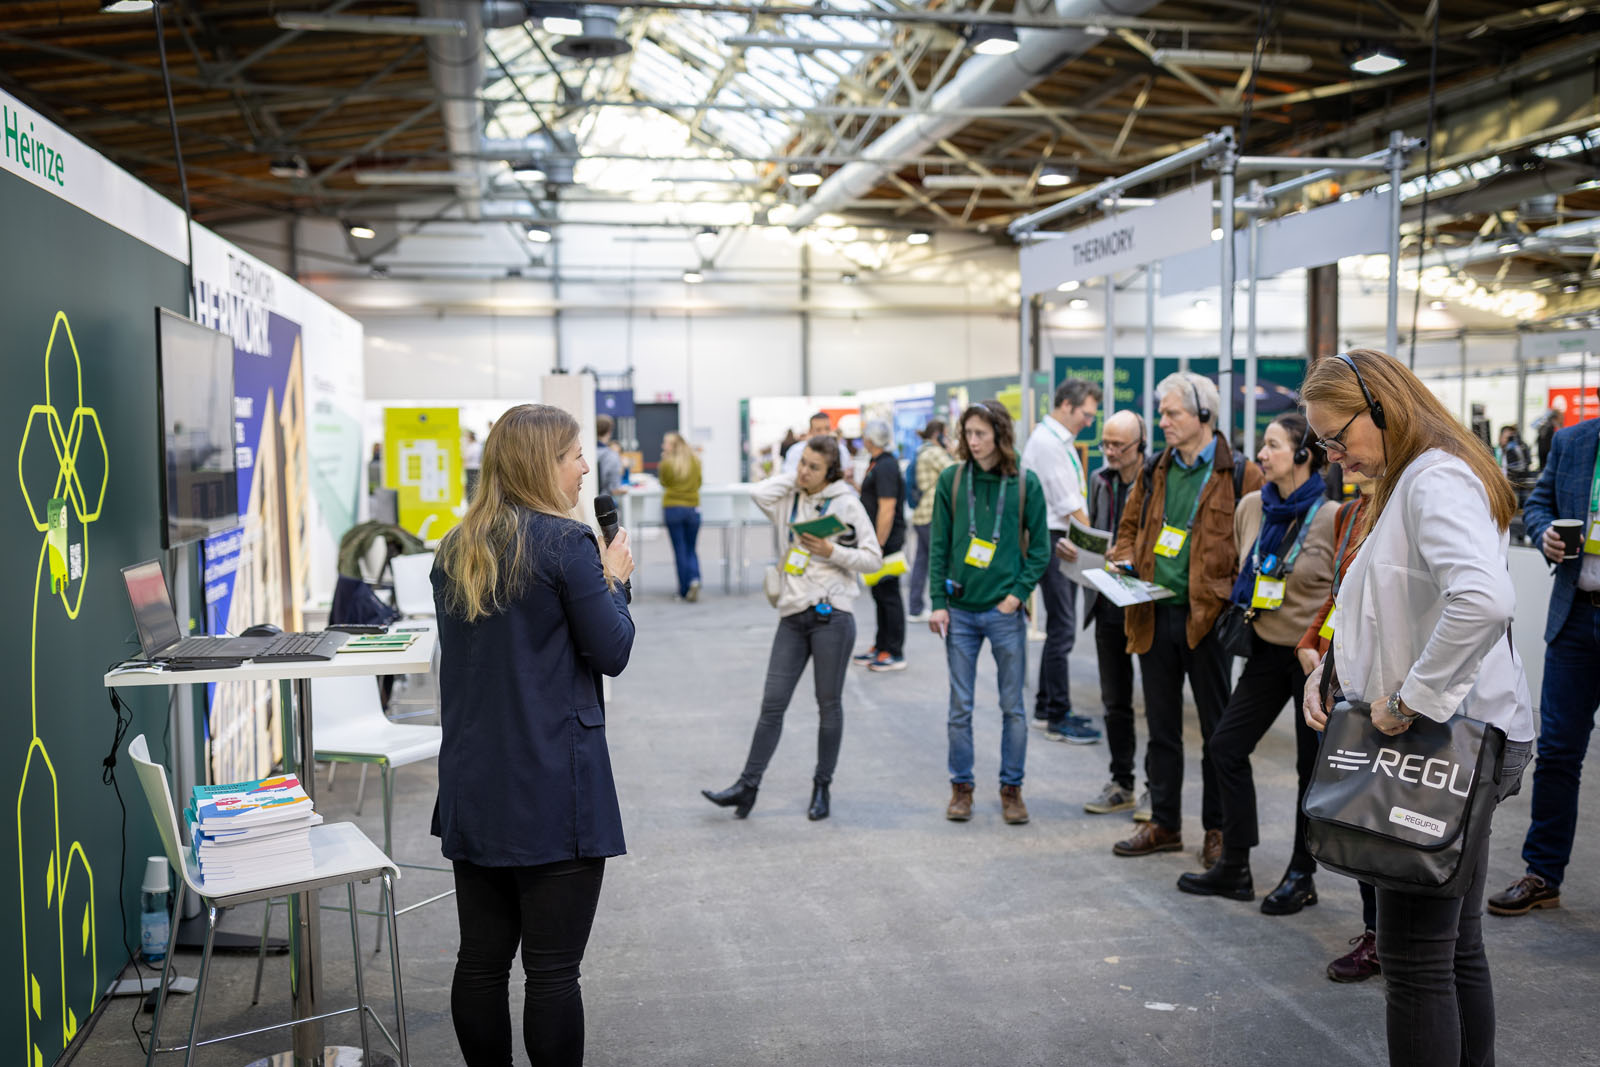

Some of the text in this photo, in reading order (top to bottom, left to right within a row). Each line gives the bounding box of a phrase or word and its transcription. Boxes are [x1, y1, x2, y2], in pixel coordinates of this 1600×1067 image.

[4, 105, 64, 187] Heinze
[1073, 225, 1135, 266] THERMORY
[1371, 748, 1475, 797] REGU
[1404, 814, 1441, 833] REGUPOL
